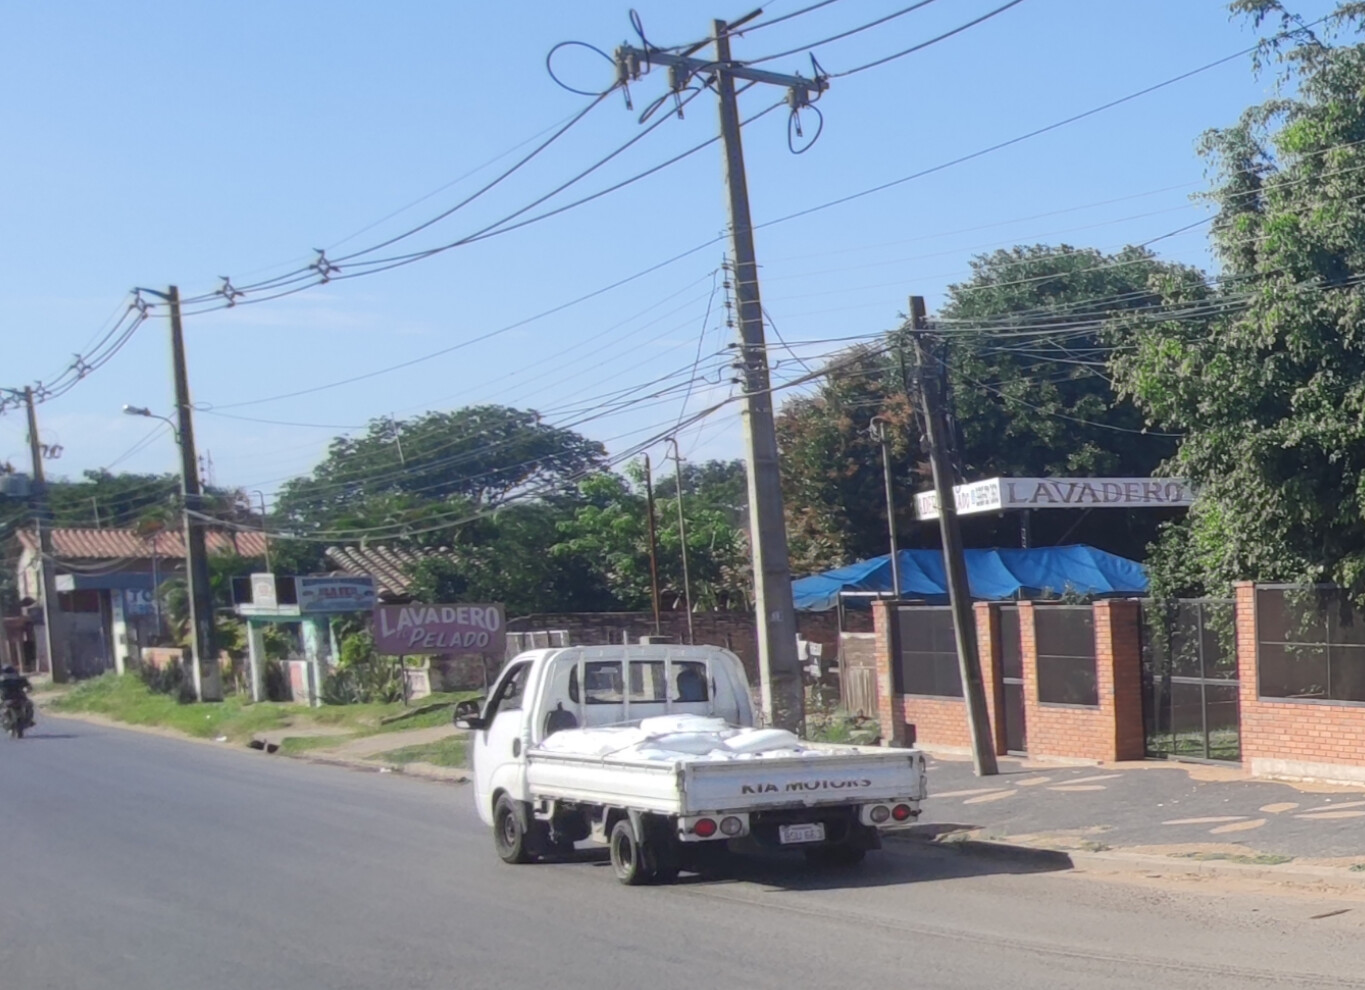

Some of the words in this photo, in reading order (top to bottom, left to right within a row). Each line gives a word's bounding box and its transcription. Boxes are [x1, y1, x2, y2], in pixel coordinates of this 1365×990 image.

[1007, 482, 1184, 504] LAVADERO
[380, 606, 500, 638] LAVADERO
[408, 627, 490, 648] PELADO
[741, 783, 779, 795] KIA
[785, 779, 872, 792] MOTORS
